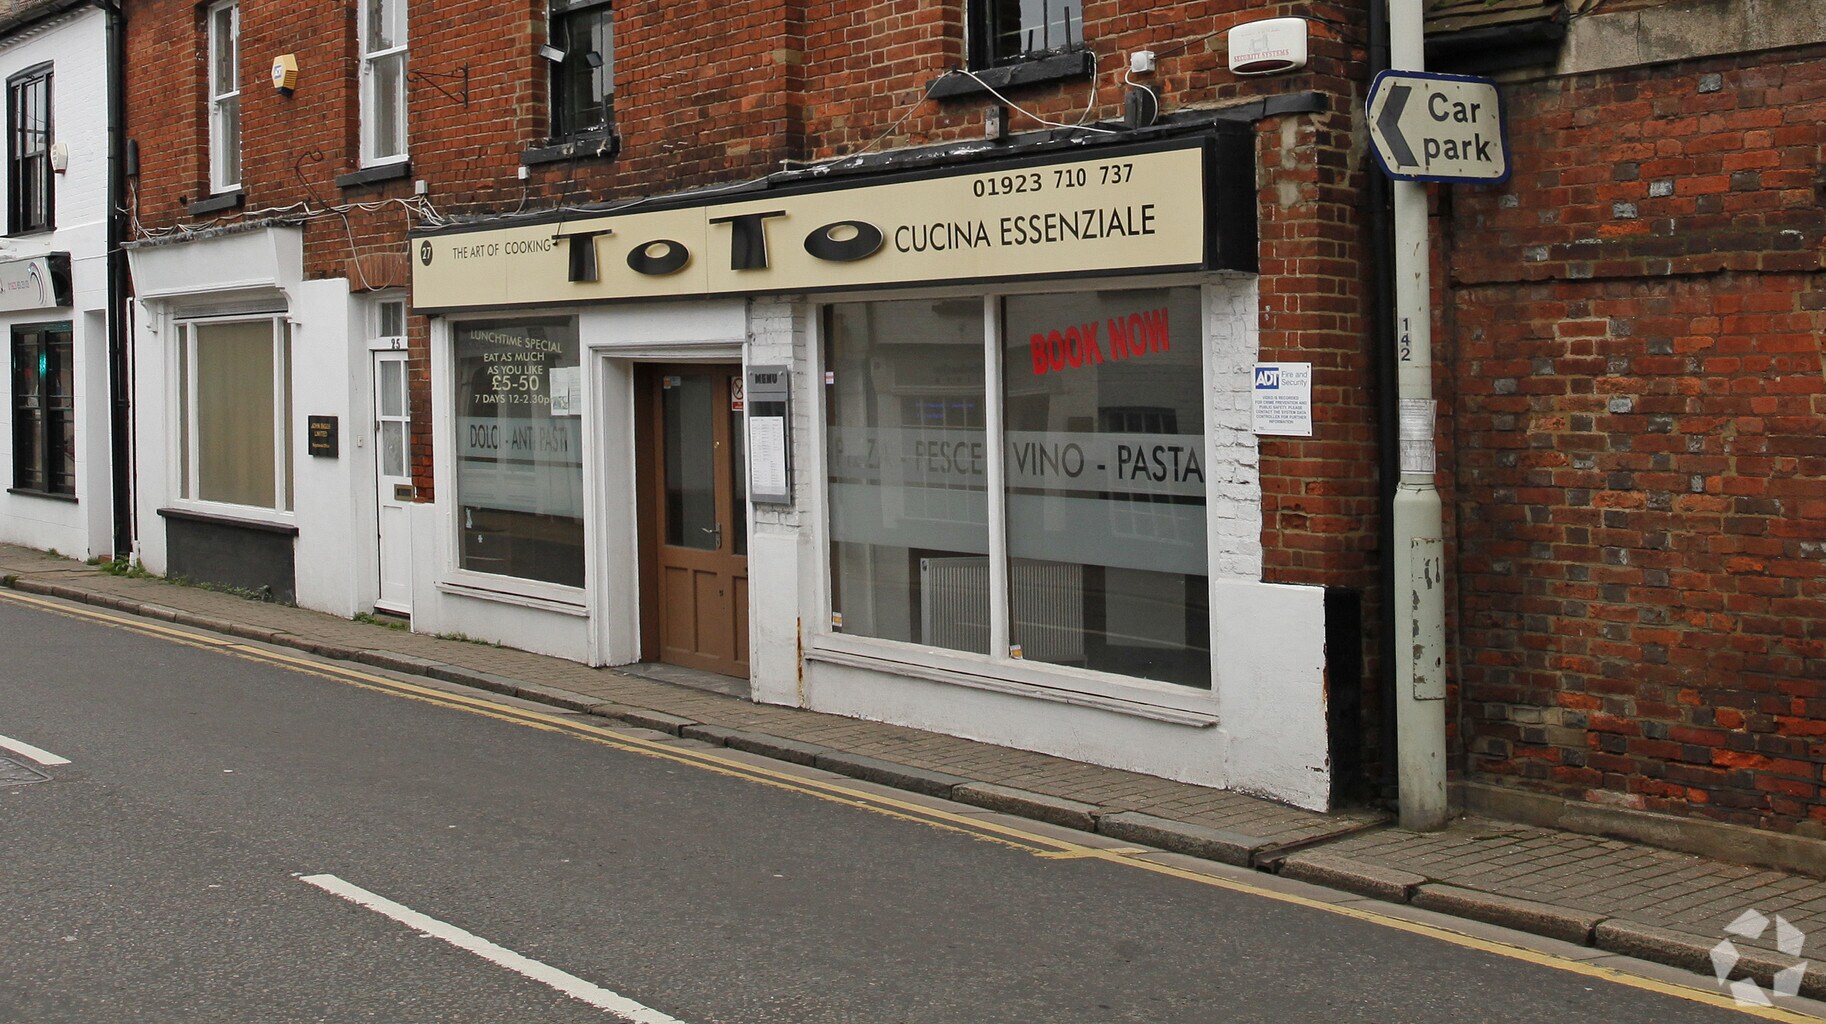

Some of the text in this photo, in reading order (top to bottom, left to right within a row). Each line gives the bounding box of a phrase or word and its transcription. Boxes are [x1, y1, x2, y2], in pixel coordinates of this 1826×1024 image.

[1233, 48, 1290, 63] SECURITY SYSTEMS
[1427, 92, 1481, 124] Car
[1423, 133, 1492, 166] park
[973, 163, 1134, 198] 01923 710 737
[895, 203, 1156, 253] CUCINA ESSENZIALE
[421, 246, 432, 260] 27
[452, 238, 551, 260] THE ART OF COOKING
[390, 338, 401, 350] 25
[470, 329, 562, 354] LUNCHTIME SPECIAL
[1029, 306, 1170, 376] BOOK NOW
[483, 351, 545, 363] EAT AS MUCH
[487, 365, 543, 375] AS YOU LIKE
[1256, 370, 1308, 386] ADT Fire and
[491, 375, 540, 392] £5-50
[754, 373, 778, 385] MENU
[1281, 378, 1308, 388] Security
[474, 394, 552, 405] 7 DAYS 12-2.30p
[915, 440, 983, 475] PESCE
[1012, 442, 1085, 478] VINO
[1117, 444, 1204, 483] PASTA
